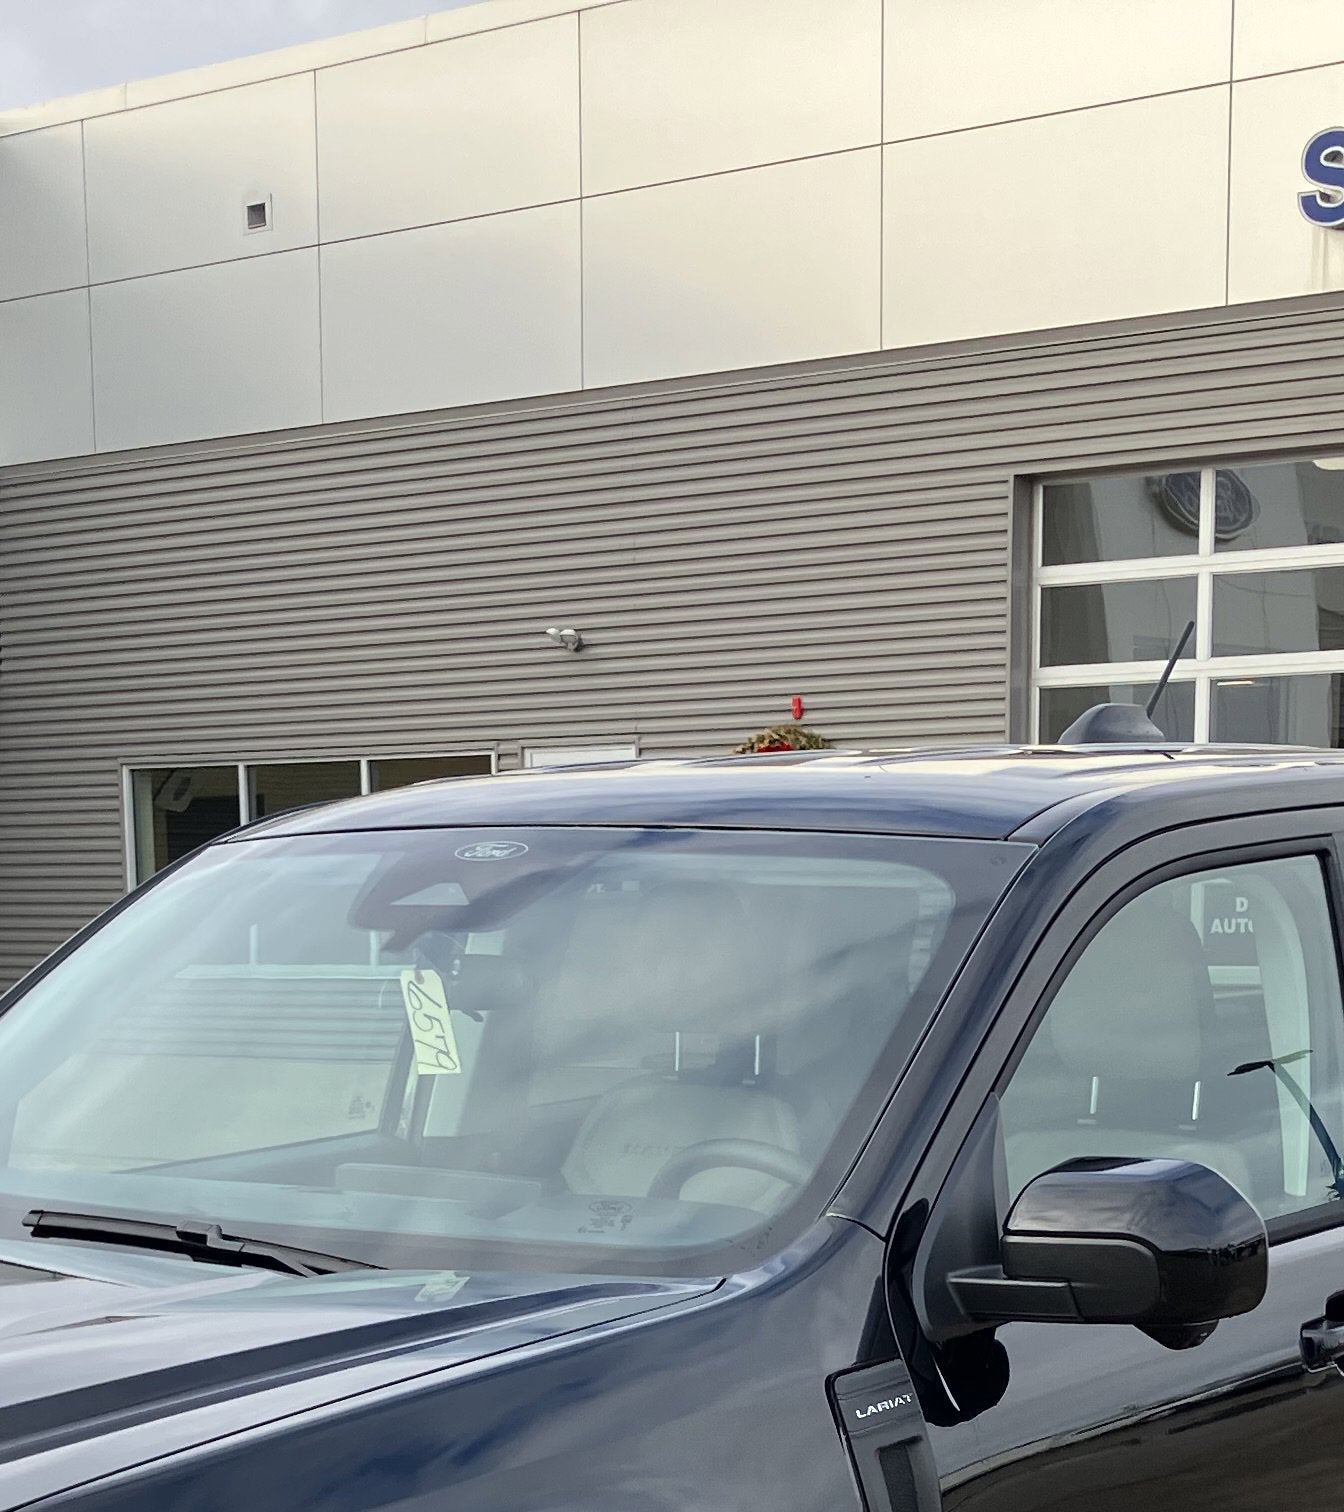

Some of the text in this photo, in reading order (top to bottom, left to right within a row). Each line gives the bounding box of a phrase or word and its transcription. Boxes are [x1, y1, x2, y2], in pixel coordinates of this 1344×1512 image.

[464, 843, 518, 858] Ford
[407, 980, 458, 1071] 6579
[855, 1393, 913, 1418] LARIAT
